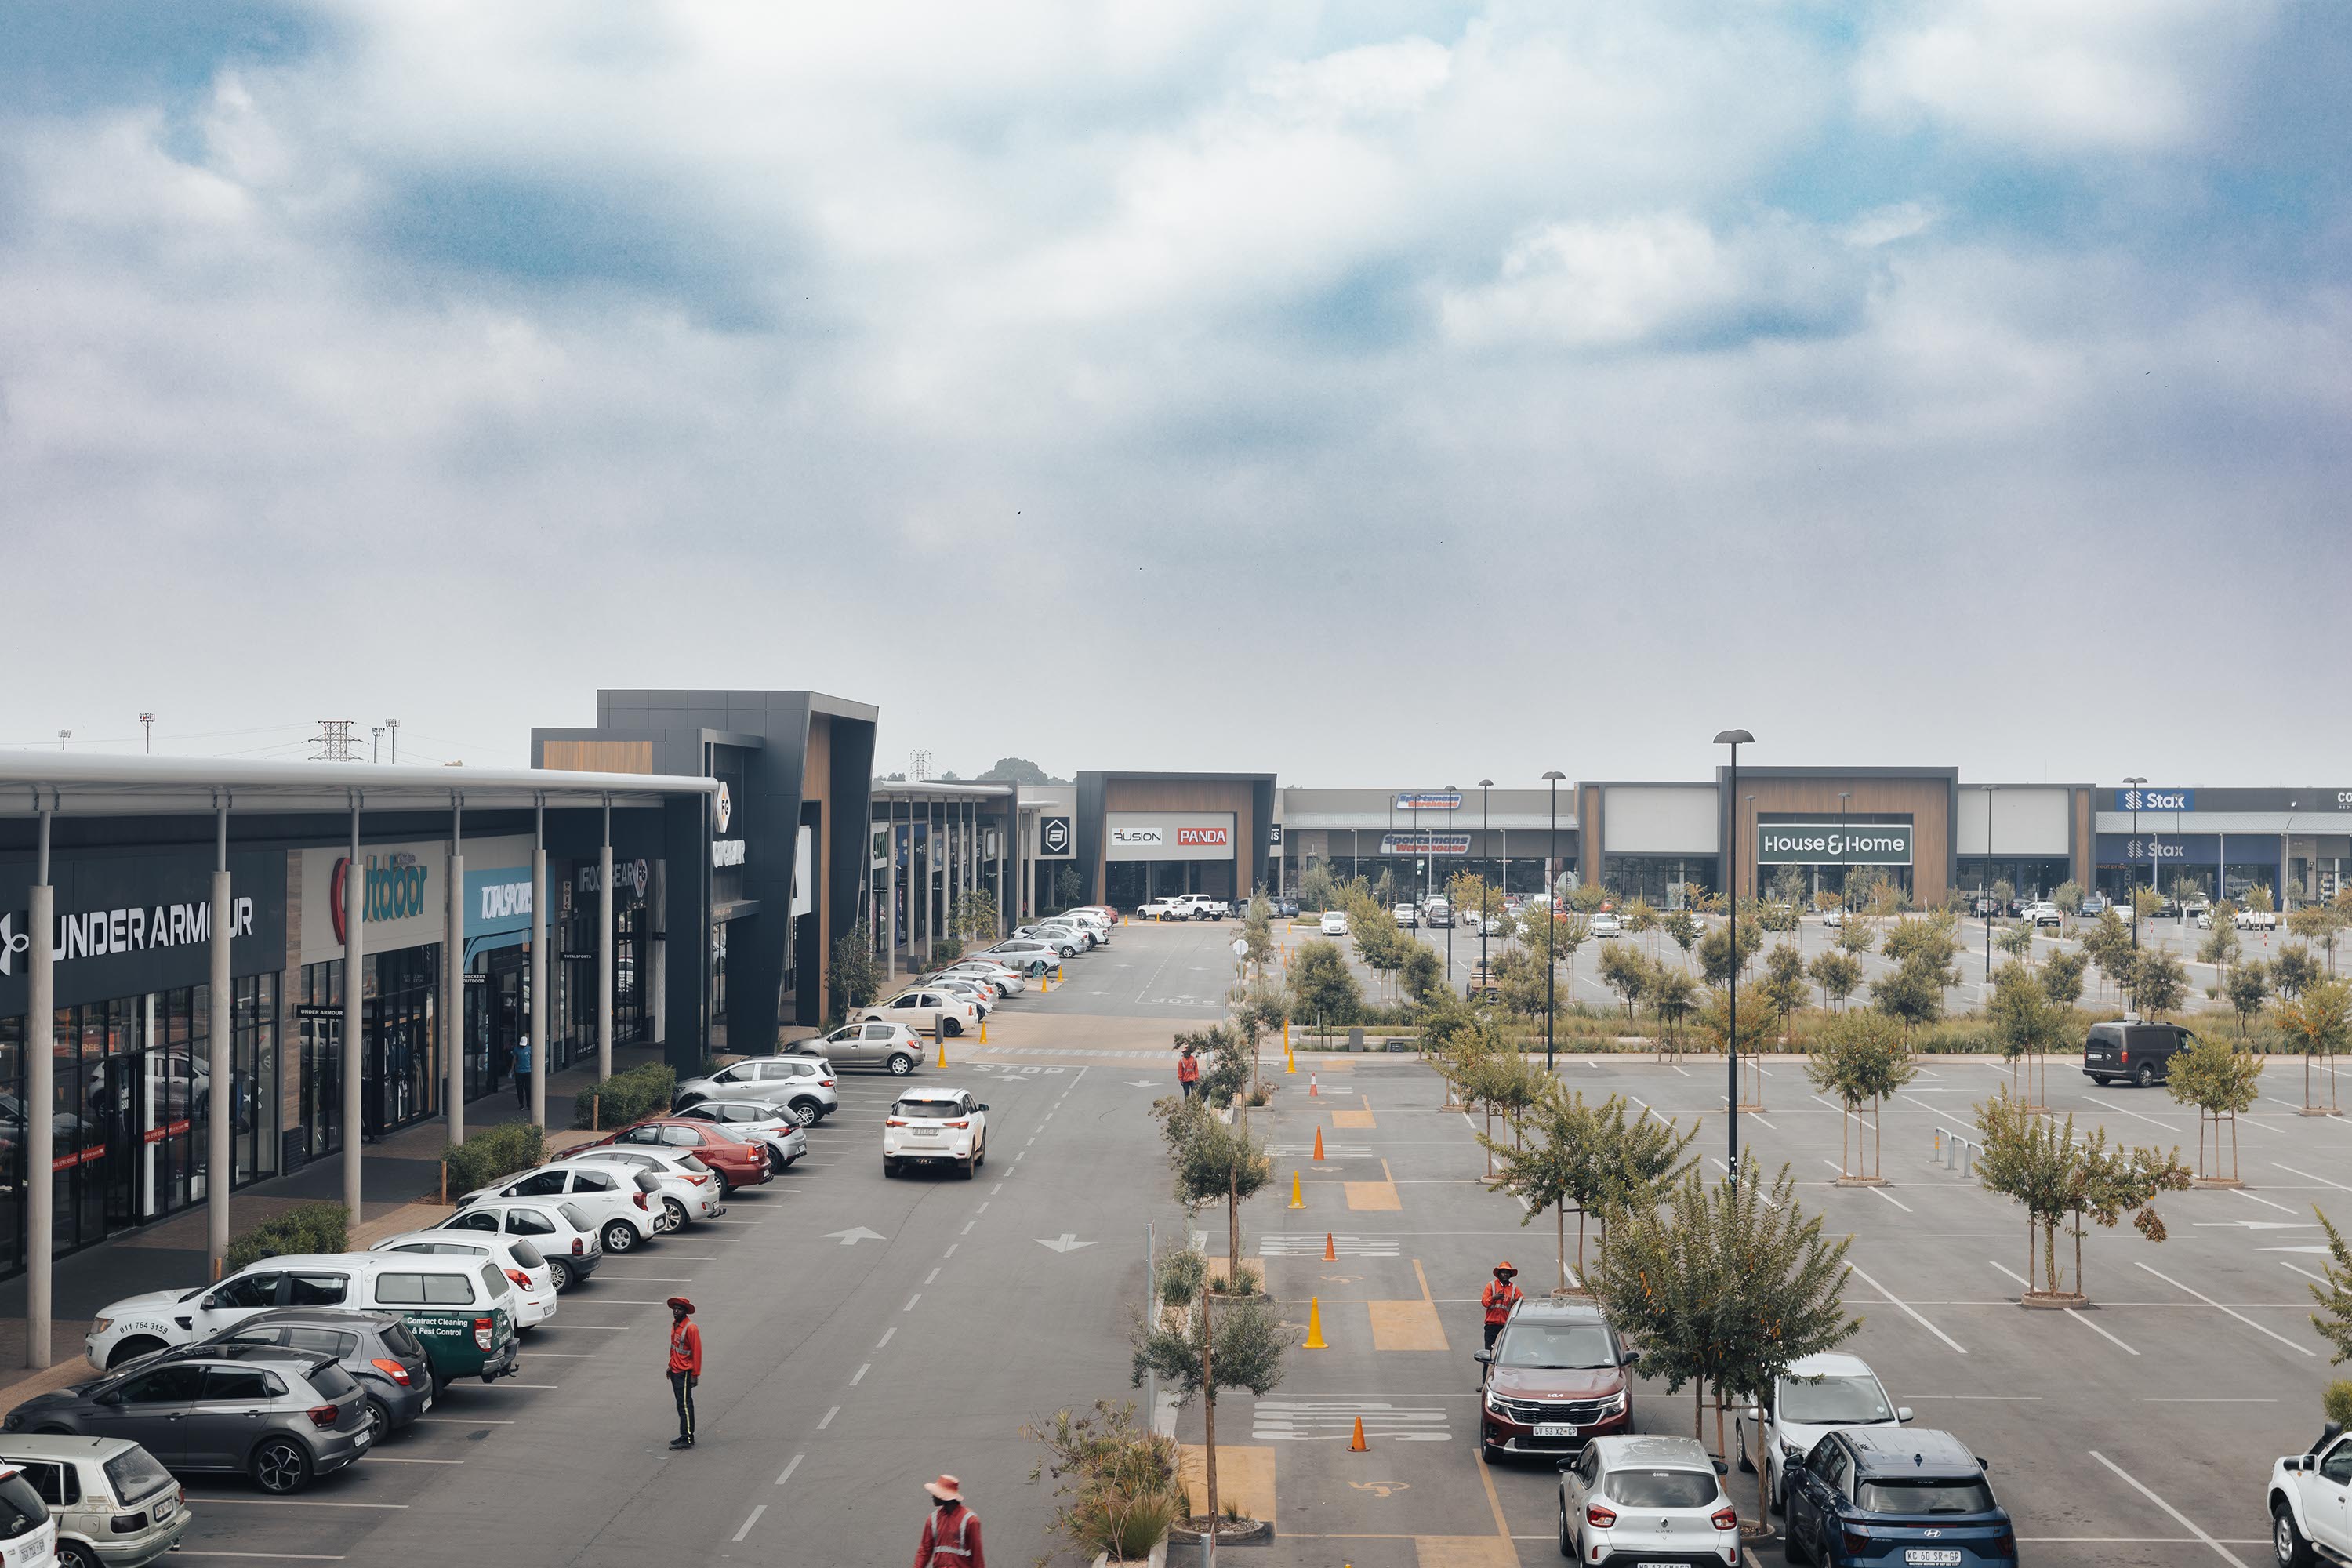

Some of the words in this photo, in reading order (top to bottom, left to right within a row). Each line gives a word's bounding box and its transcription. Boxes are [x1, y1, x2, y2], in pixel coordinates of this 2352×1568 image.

[2147, 793, 2185, 808] Stax
[1113, 829, 1161, 842] FUSION
[1180, 830, 1226, 843] PANDA
[1385, 836, 1468, 846] Sportsmans
[2147, 843, 2184, 857] Stax
[53, 907, 145, 962] UNDER
[150, 896, 252, 949] ARMUR
[972, 1065, 1066, 1075] STOP
[119, 1323, 132, 1334] 011
[150, 1323, 169, 1334] 3159
[437, 1318, 468, 1328] Cleaning
[1907, 1552, 1918, 1560] KC
[1921, 1552, 1930, 1560] 60
[1933, 1552, 1943, 1561] SR
[1949, 1552, 1959, 1561] GP
